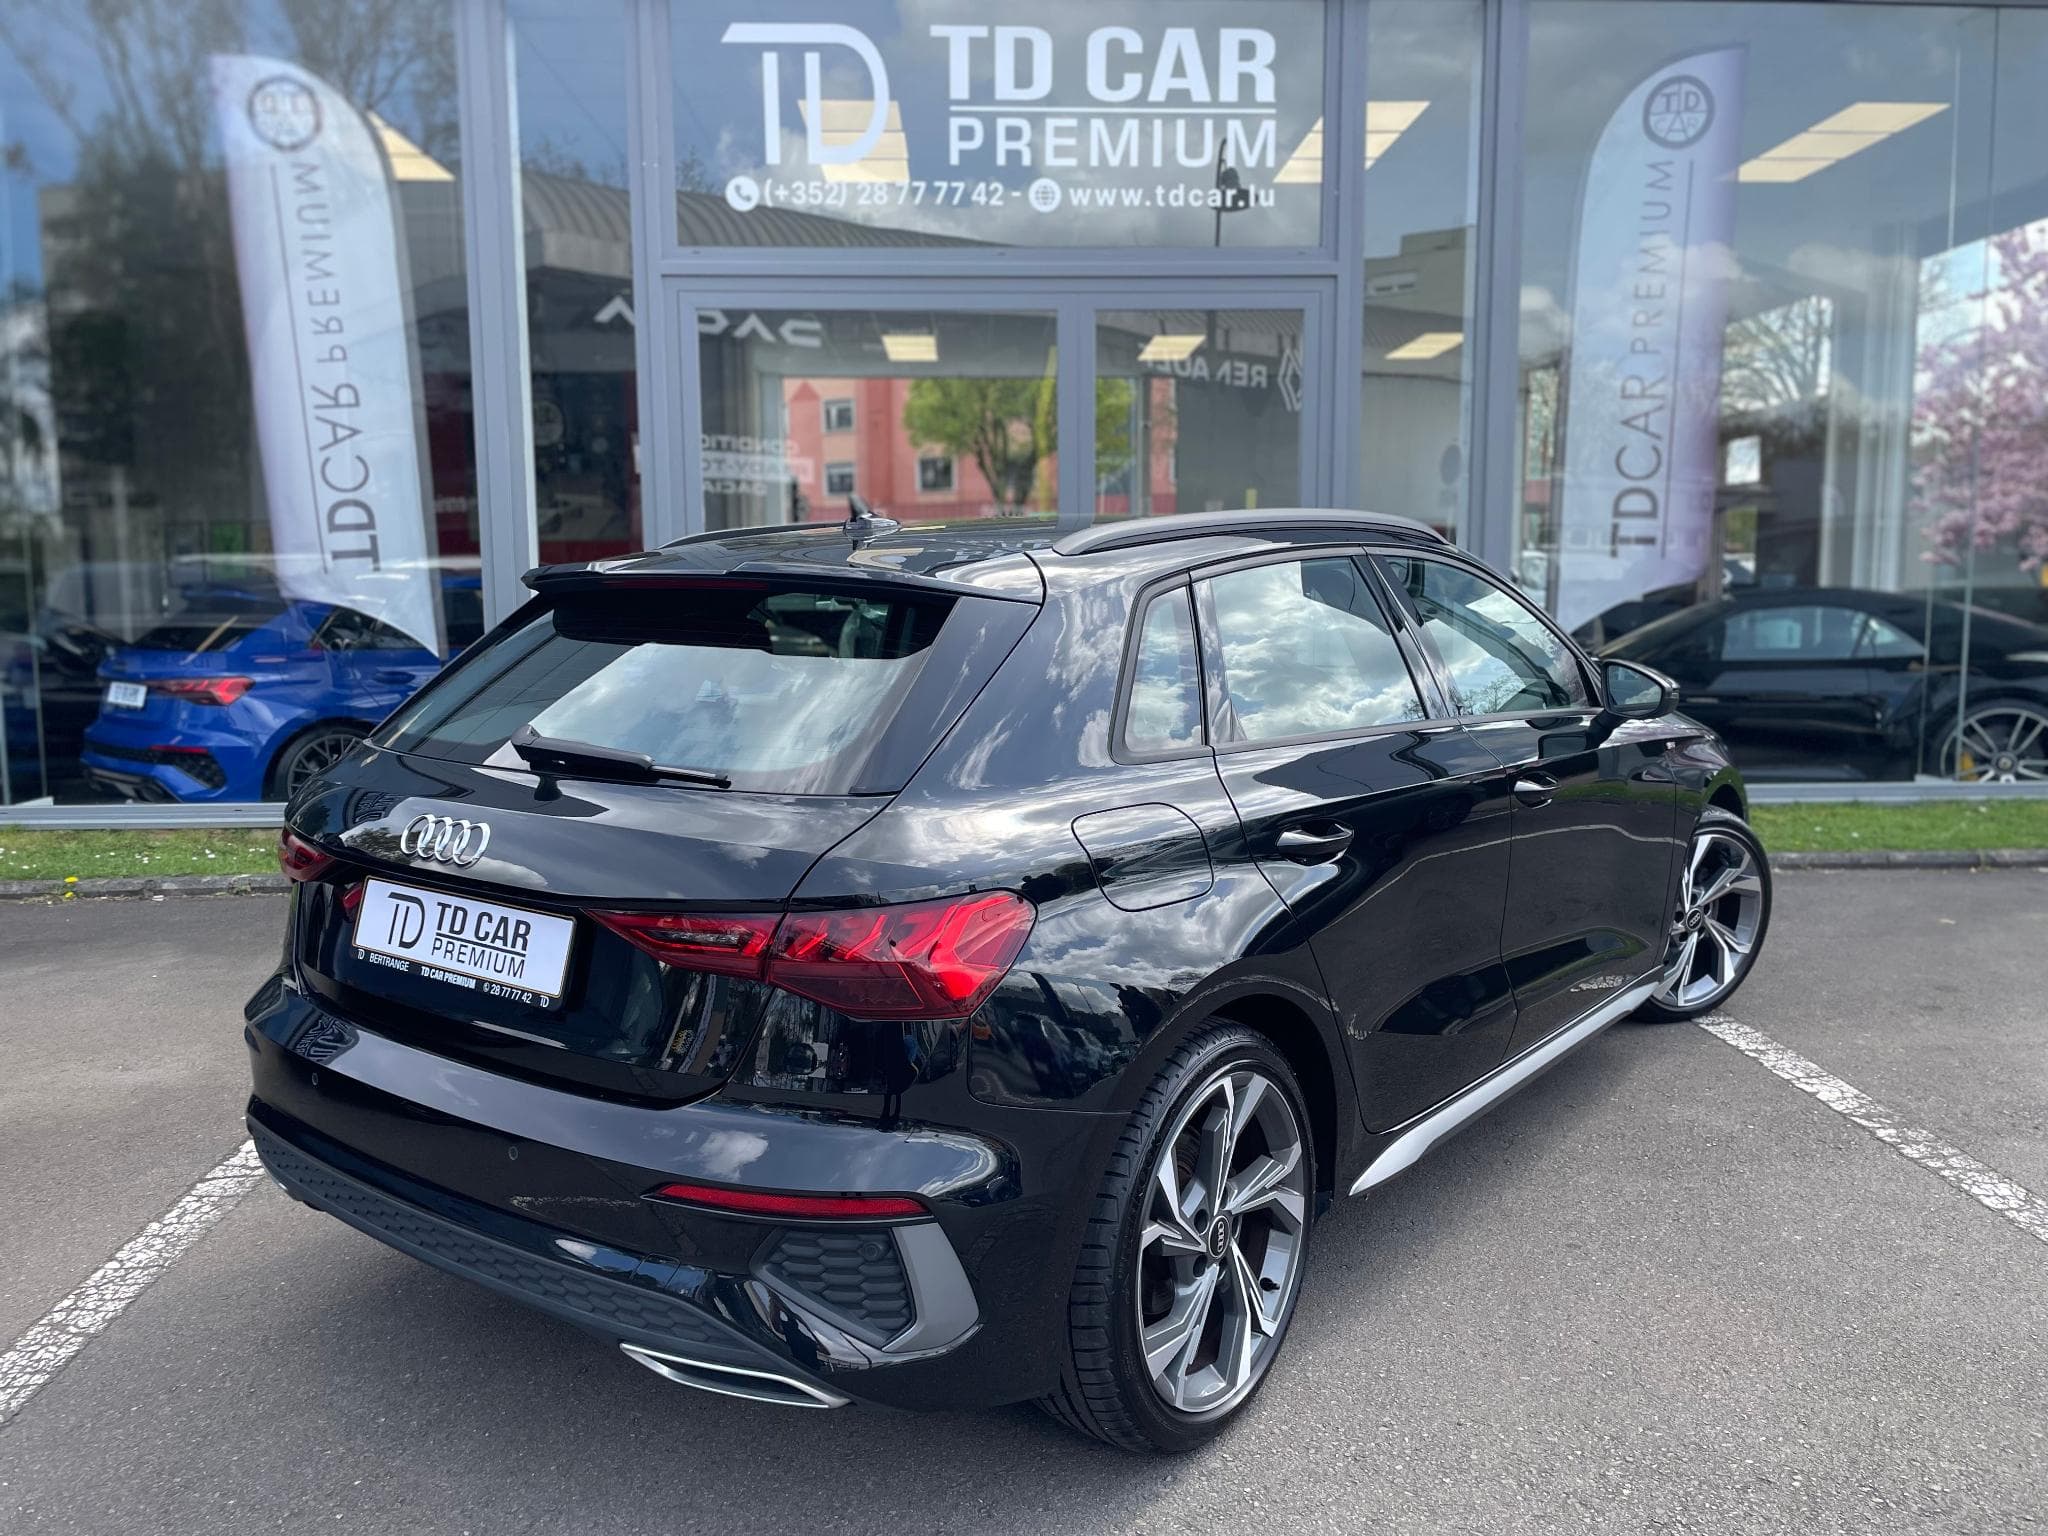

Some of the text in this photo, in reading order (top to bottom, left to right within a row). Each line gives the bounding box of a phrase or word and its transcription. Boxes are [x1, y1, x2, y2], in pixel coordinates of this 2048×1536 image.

[929, 24, 1277, 103] TD CAR
[949, 117, 1277, 169] PREMIUM
[763, 178, 848, 208] (+352)
[856, 180, 888, 206] 28
[896, 181, 927, 206] 77
[934, 181, 966, 206] 77
[971, 181, 1005, 206] 42
[1069, 183, 1276, 207] www.tdcar.lu
[1629, 159, 1676, 355] PREMIUM
[436, 901, 531, 952] TD CAR
[369, 952, 410, 972] BERTRANGE
[421, 966, 430, 978] TD
[430, 968, 444, 981] CAR
[443, 973, 477, 990] PREMIUM
[490, 983, 501, 997] 28
[501, 987, 511, 999] 77
[511, 989, 521, 1001] 77
[521, 992, 533, 1004] 42
[431, 938, 526, 980] PREMIUM
